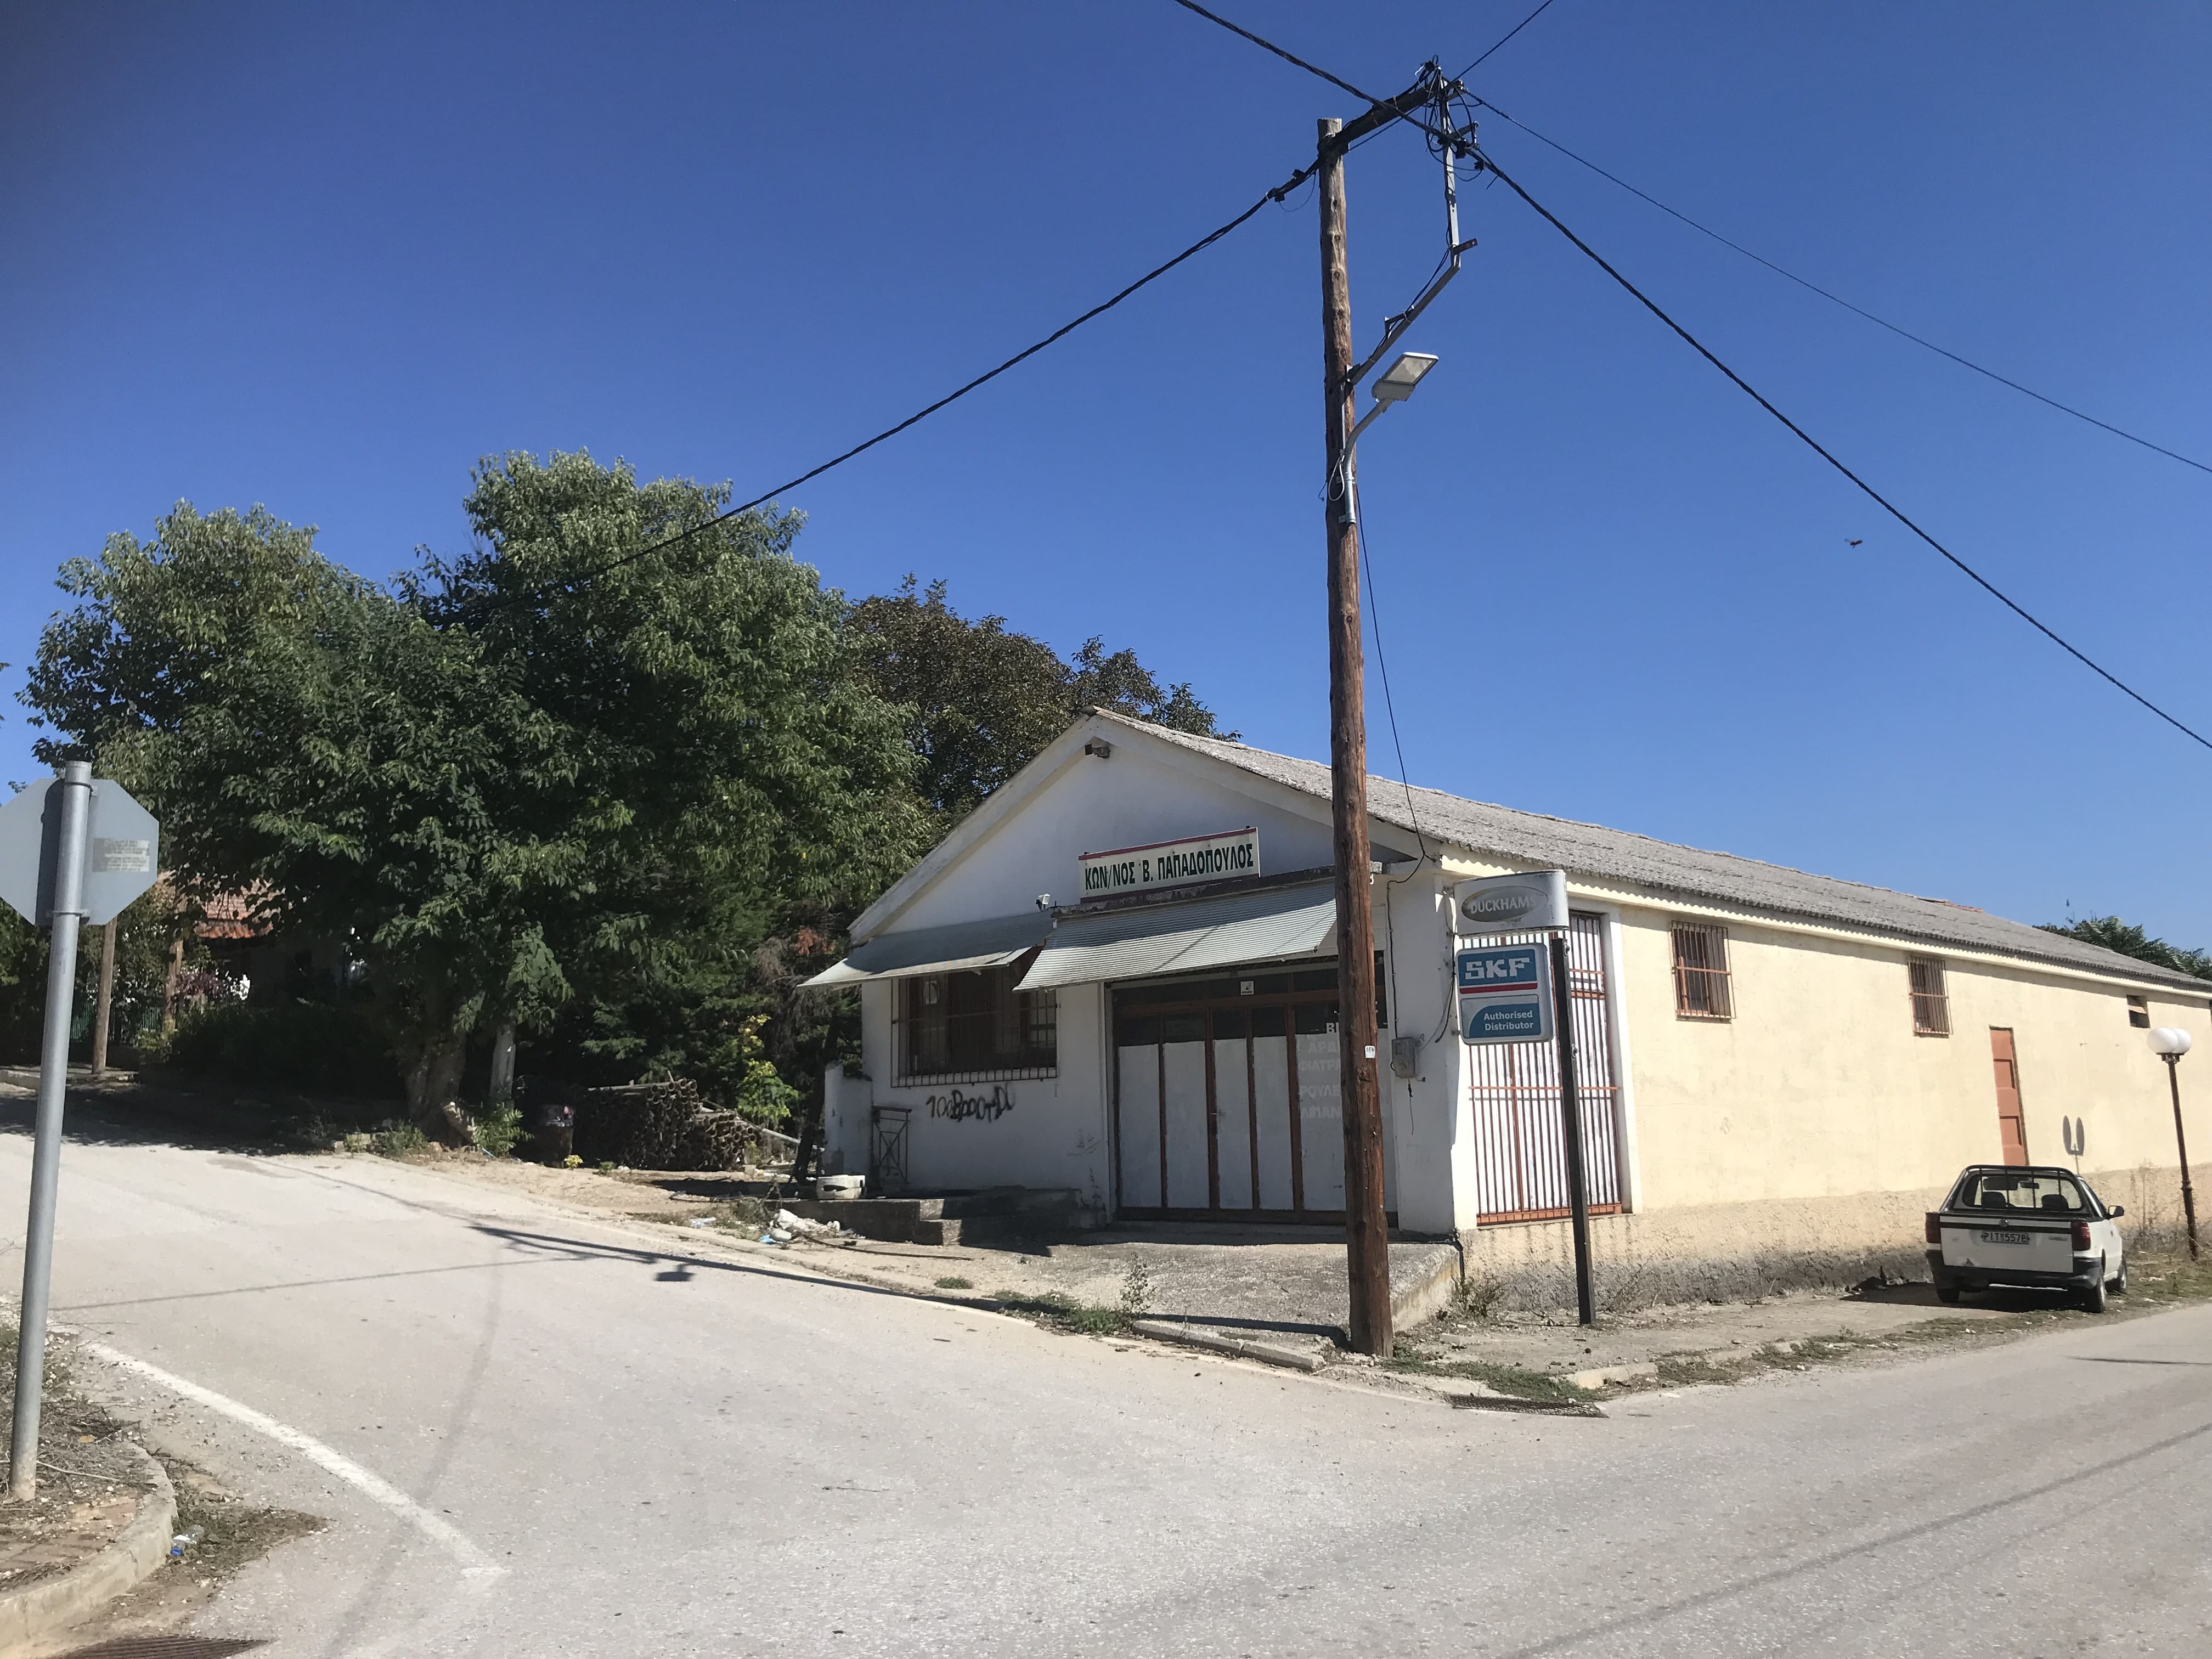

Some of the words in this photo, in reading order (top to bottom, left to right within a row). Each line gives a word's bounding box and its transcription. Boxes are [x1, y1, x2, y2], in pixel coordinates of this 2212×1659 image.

[1085, 861, 1136, 890] ΚΩΝ/ΝΟΣ
[1142, 860, 1153, 883] Β.
[1158, 843, 1254, 881] ΠΑΠΑΔΟΠΟΥΛΟΣ
[1470, 895, 1536, 914] DUCKHAMS
[1465, 957, 1530, 980] SKF
[1483, 1010, 1533, 1020] Authorised
[1485, 1022, 1534, 1031] Distributor
